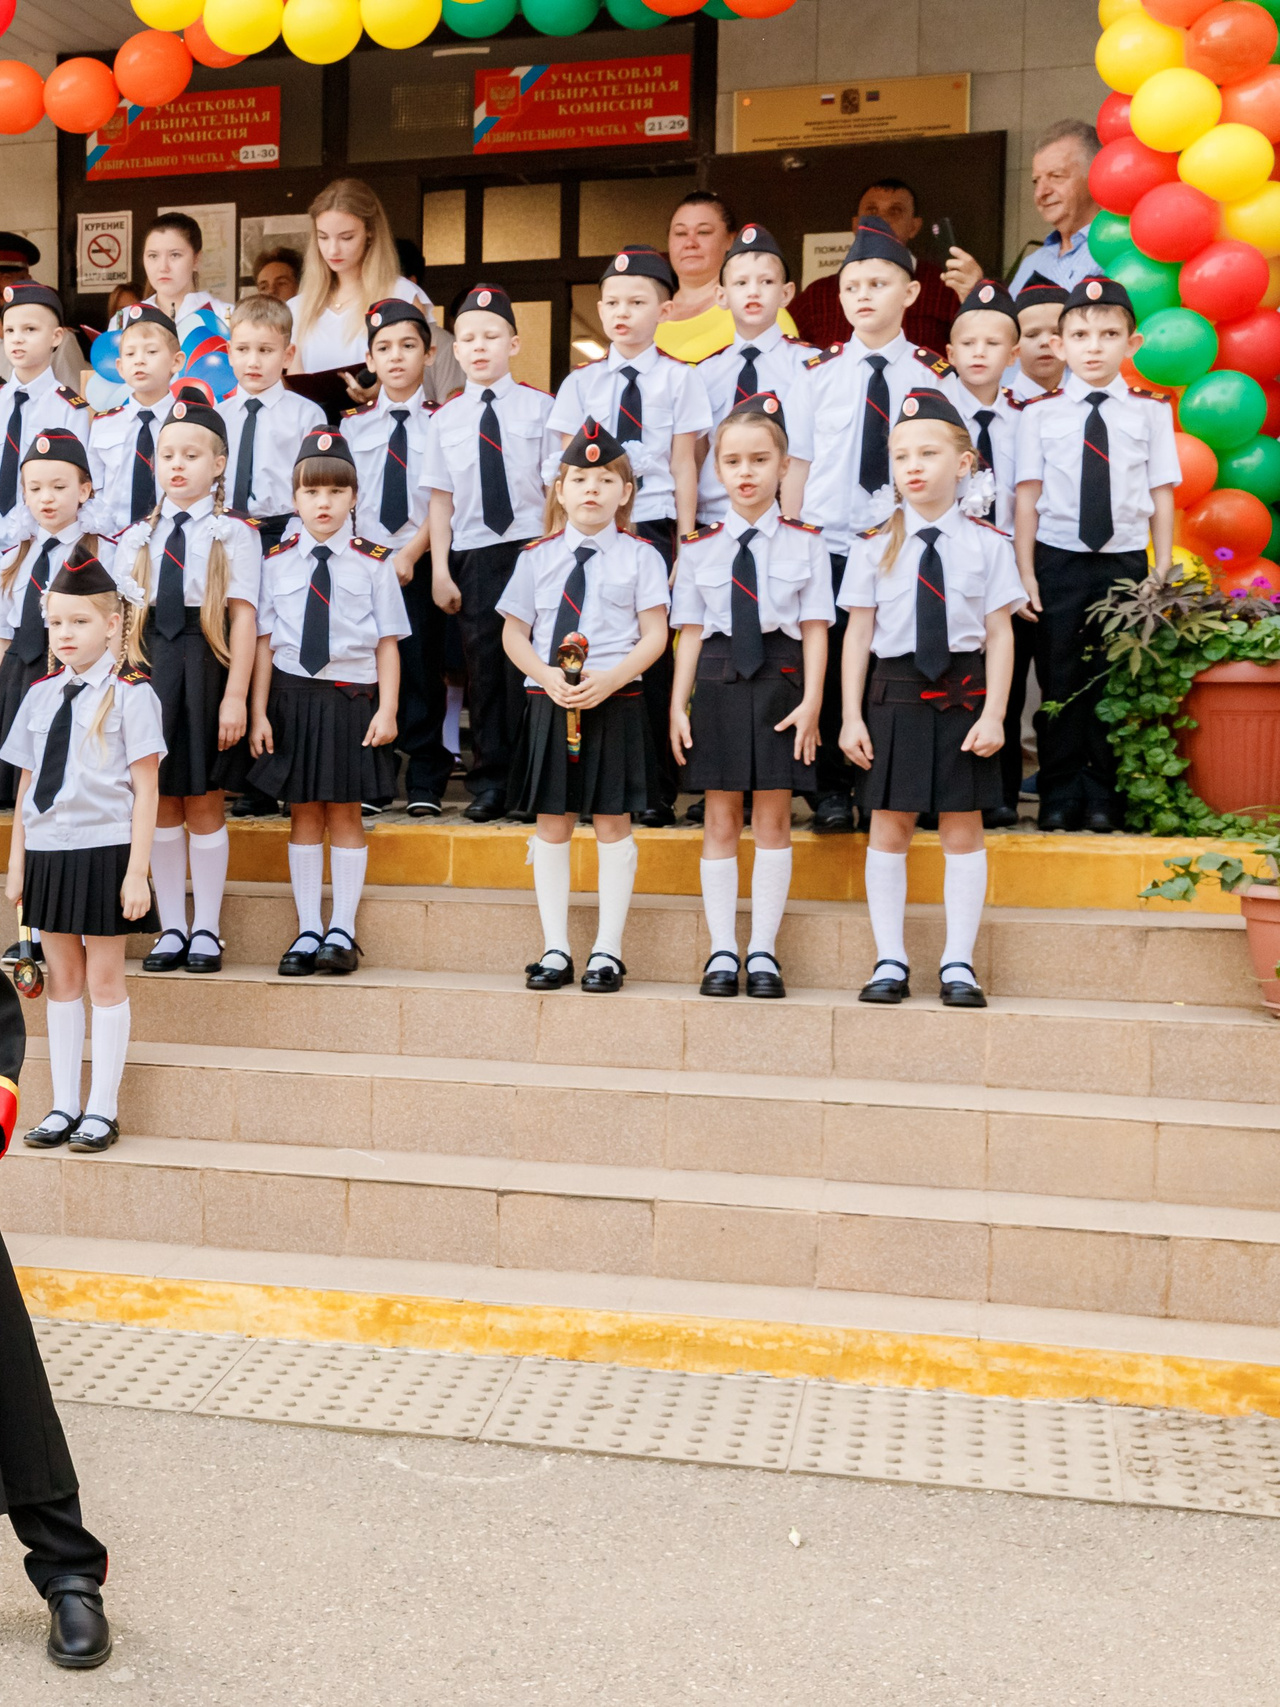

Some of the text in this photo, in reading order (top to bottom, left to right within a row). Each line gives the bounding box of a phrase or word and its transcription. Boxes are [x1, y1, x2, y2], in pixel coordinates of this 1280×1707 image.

[551, 66, 663, 84] УЧАСТКОВАЯ
[534, 80, 679, 102] ИЗБИРАТЕЛЬНАЯ
[156, 97, 256, 116] УЧАСТКОВАЯ
[558, 98, 654, 115] КОМИССИЯ
[140, 111, 271, 131] ИЗБИРАТЕЛЬНАЯ
[162, 128, 248, 144] КОМИССИЯ
[483, 126, 576, 143] ИЗБИРАТЕЛЬНОГО
[580, 123, 627, 138] УЧАСТКА
[648, 119, 685, 131] 21-29
[95, 155, 178, 171] ИЗБИРАТЕЛЬНОГО
[182, 151, 224, 165] УЧАСТКА
[242, 149, 276, 159] 21-30
[84, 221, 125, 231] КУРЕНИЕ
